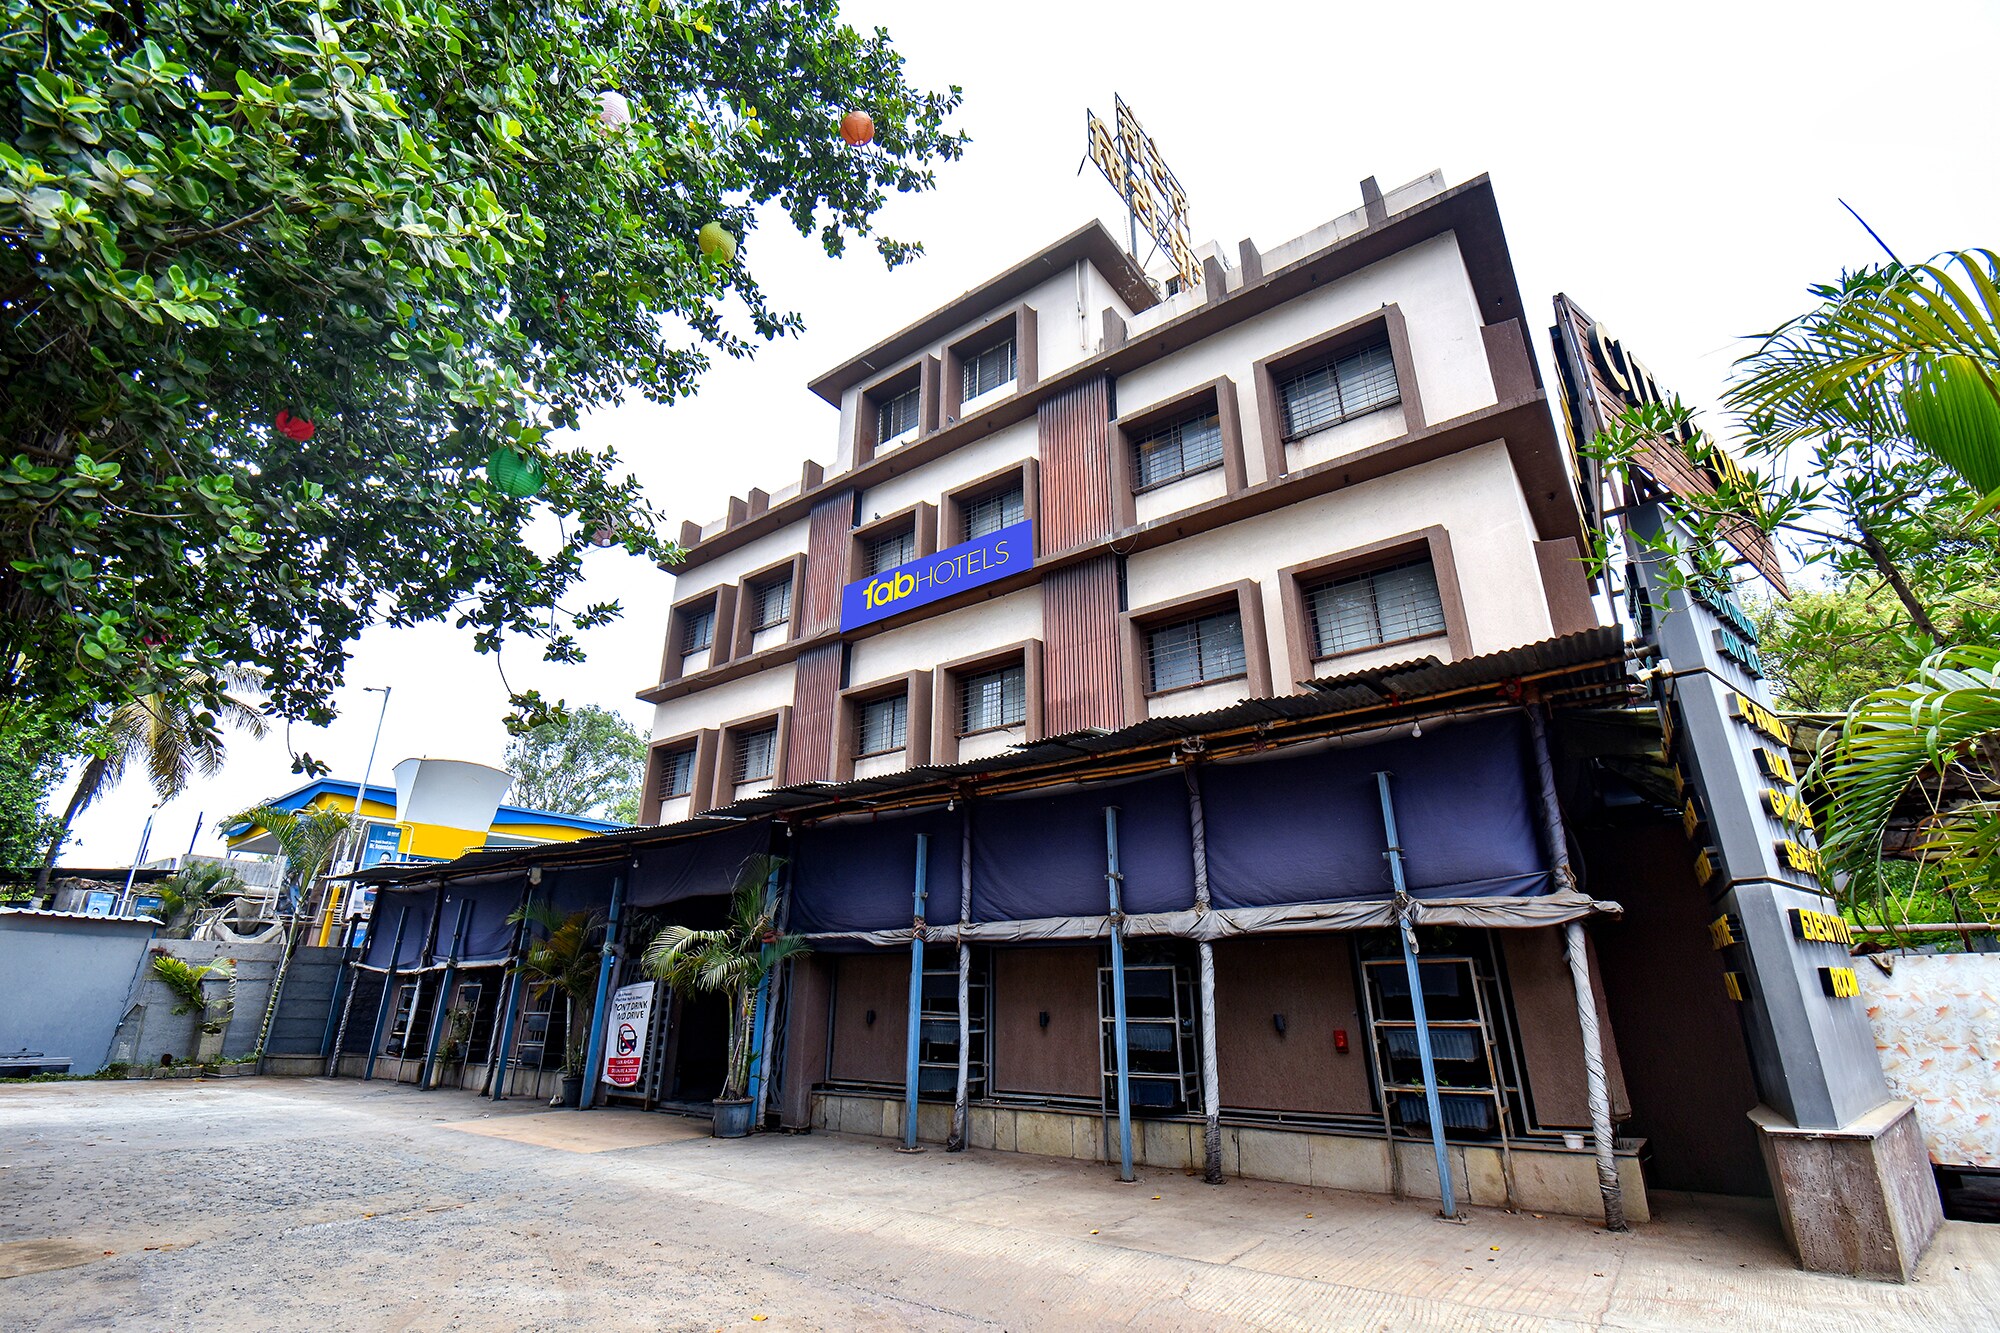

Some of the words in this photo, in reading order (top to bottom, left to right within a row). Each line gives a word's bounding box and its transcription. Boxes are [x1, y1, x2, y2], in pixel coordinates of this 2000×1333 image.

[1735, 692, 1754, 724] AC
[1752, 703, 1792, 747] FAMILY
[1763, 747, 1797, 786] HALL
[1798, 908, 1855, 945] EXECUTIVE
[1829, 966, 1860, 998] ROOM
